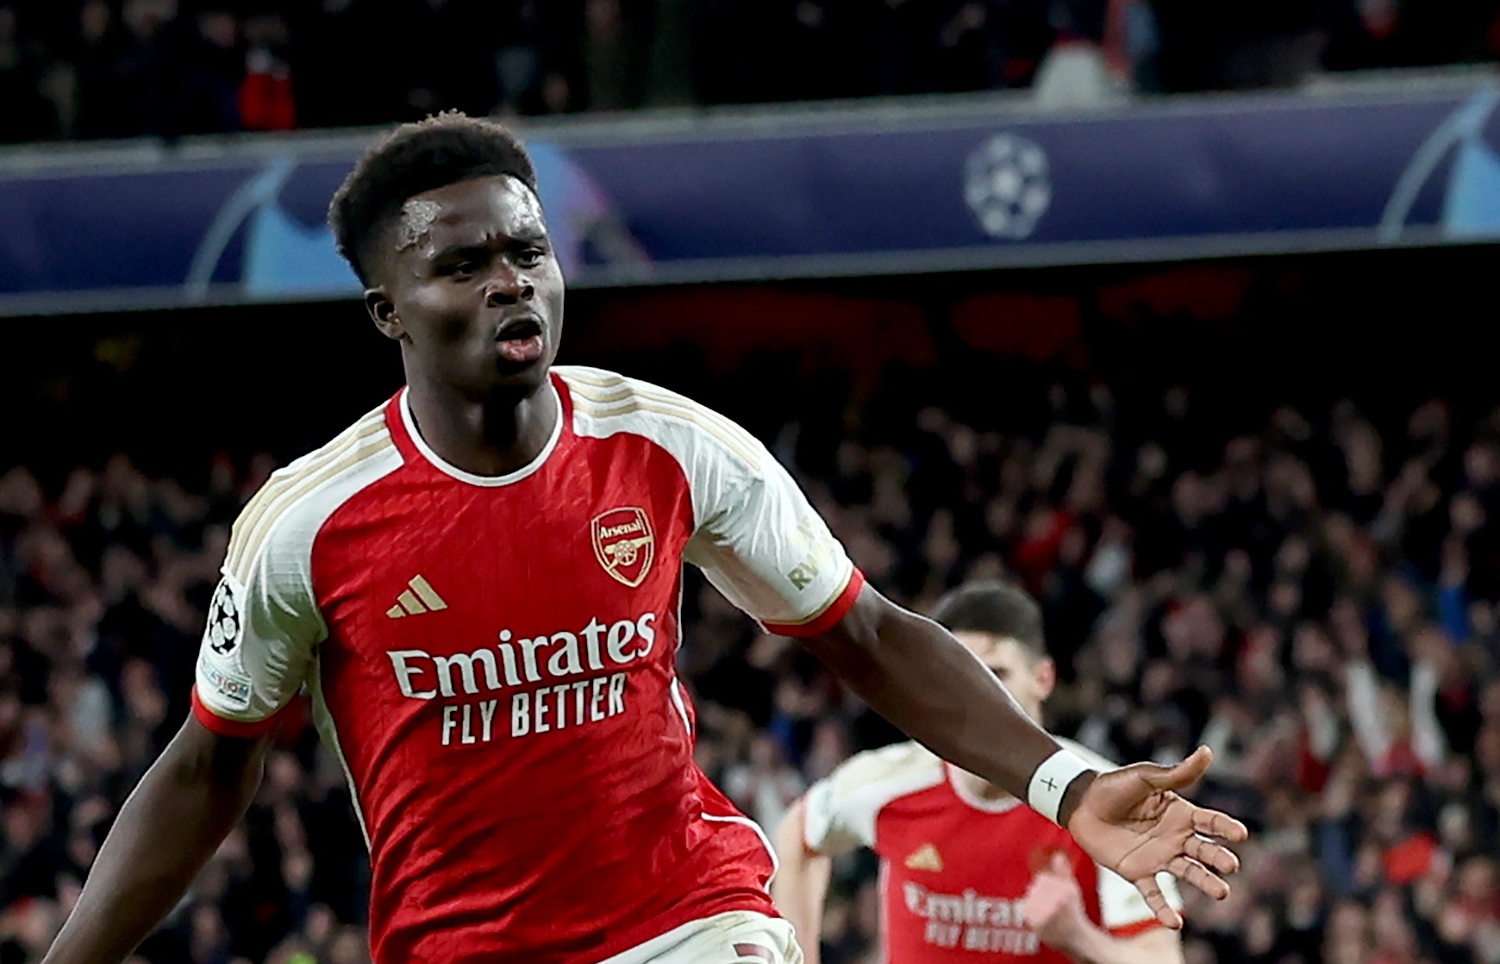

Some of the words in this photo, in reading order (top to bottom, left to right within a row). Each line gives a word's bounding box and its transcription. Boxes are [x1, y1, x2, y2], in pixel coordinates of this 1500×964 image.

[600, 518, 643, 539] Arsenal
[386, 612, 656, 700] Emirates
[441, 699, 498, 746] FLY
[511, 672, 627, 738] BETTER
